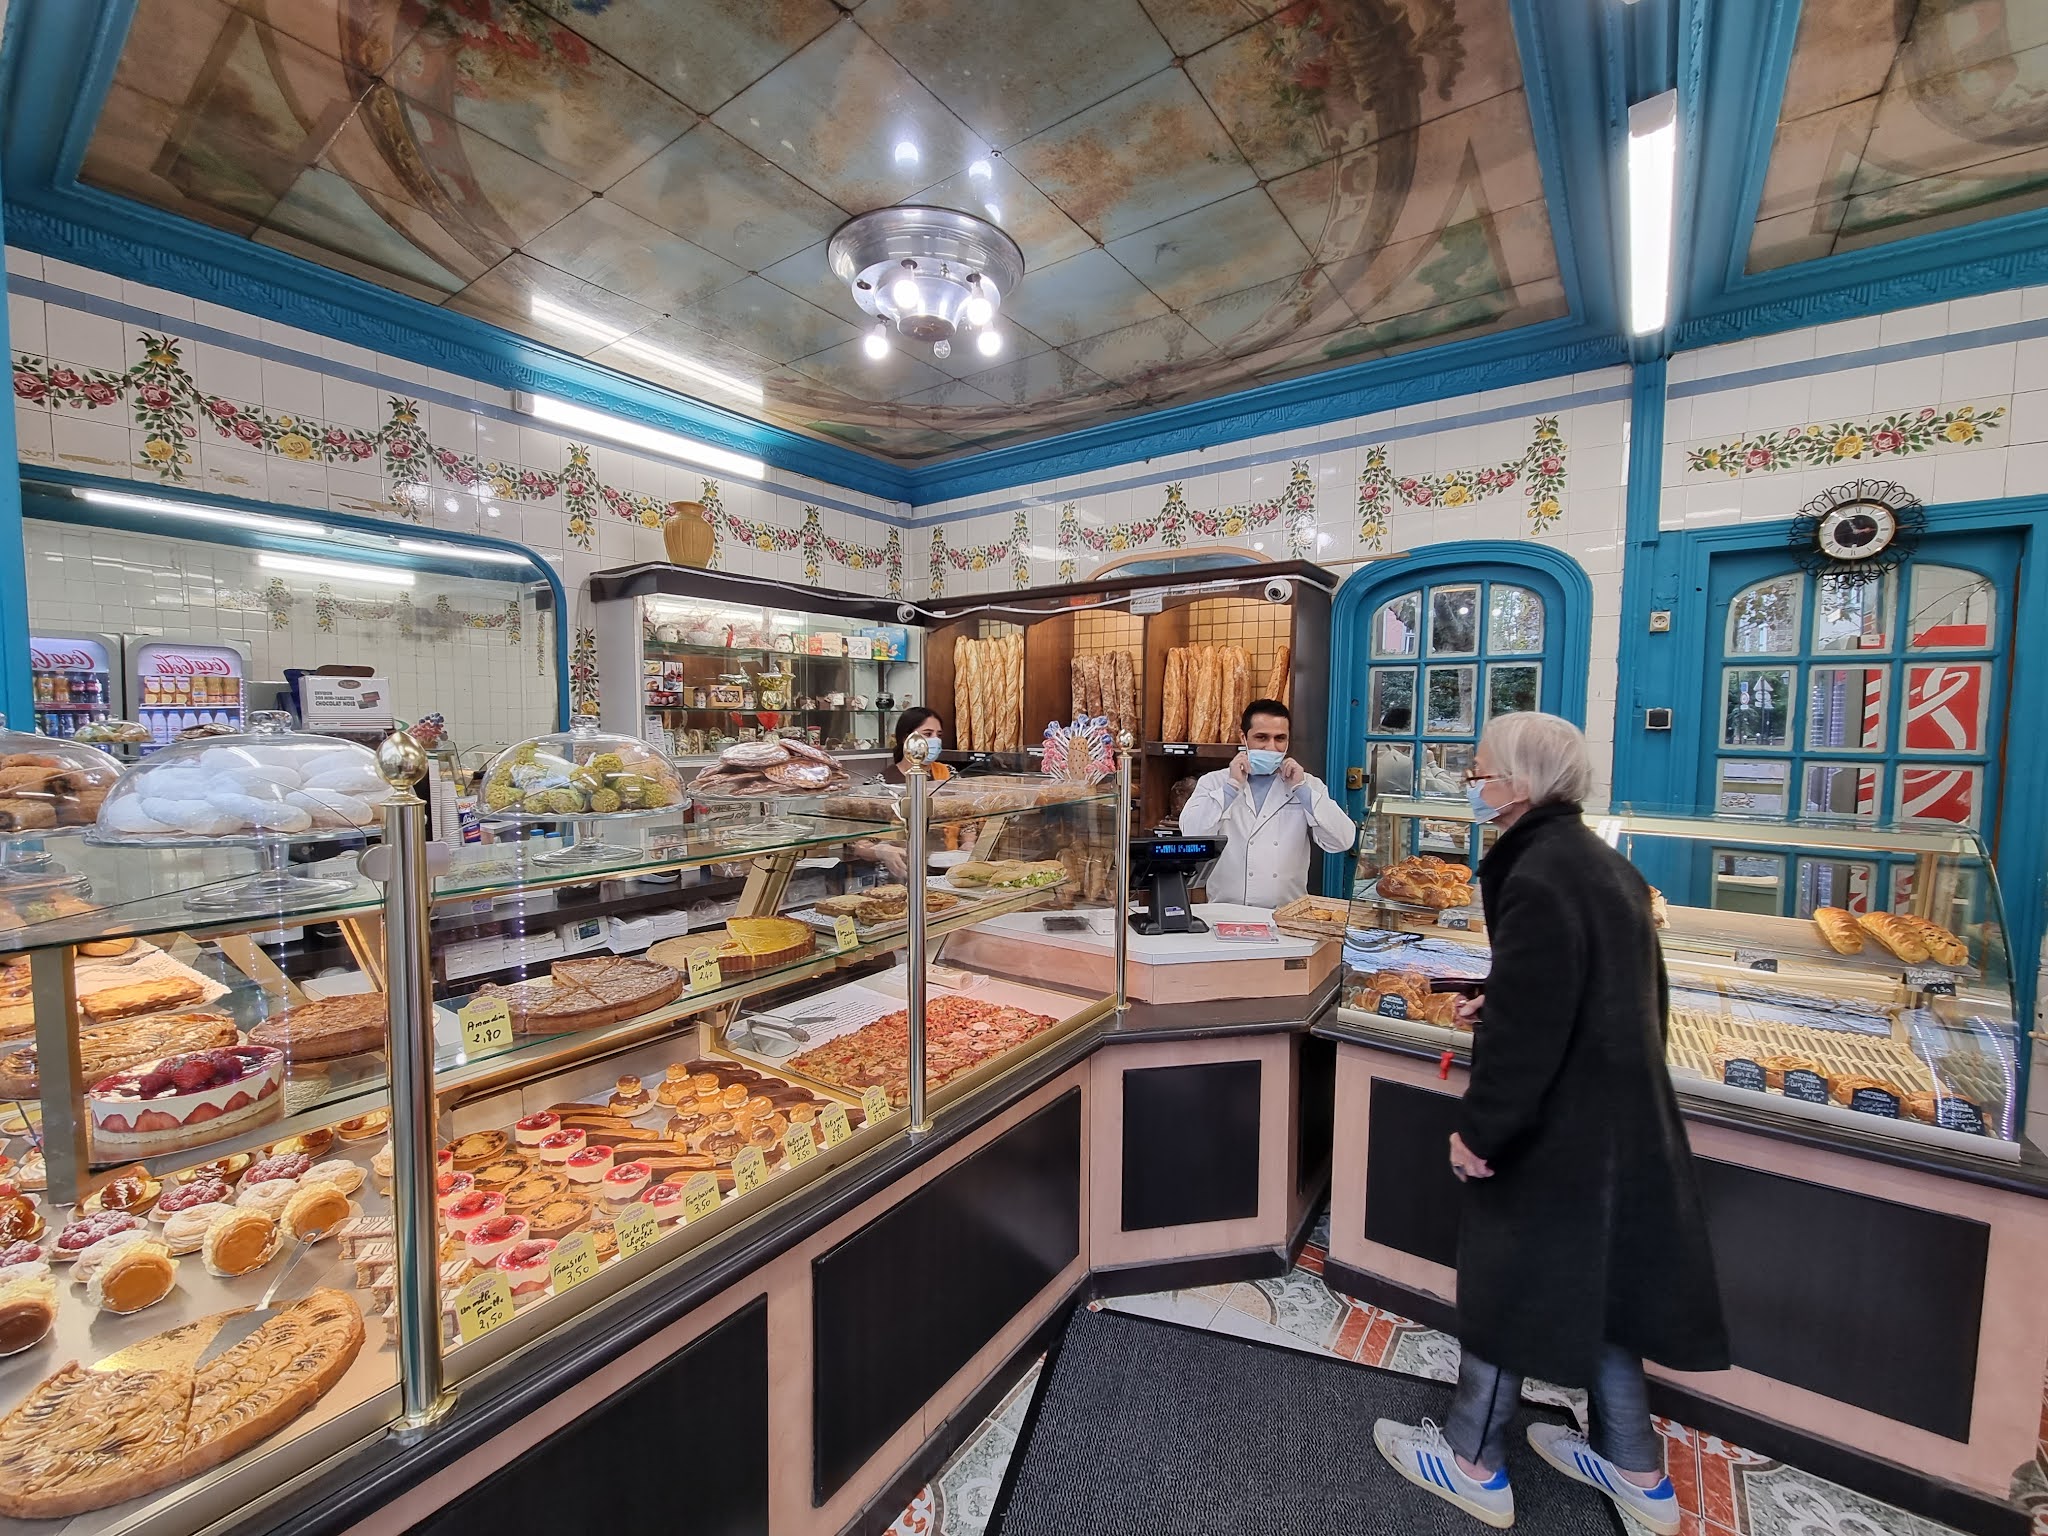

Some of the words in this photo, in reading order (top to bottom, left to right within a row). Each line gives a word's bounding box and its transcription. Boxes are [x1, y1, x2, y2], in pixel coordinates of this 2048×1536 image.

[472, 1029, 502, 1044] 2,80
[693, 1199, 711, 1214] 3,50
[553, 1251, 588, 1278] Fraisier
[566, 1264, 590, 1285] 3,50
[479, 1312, 503, 1330] 2,50
